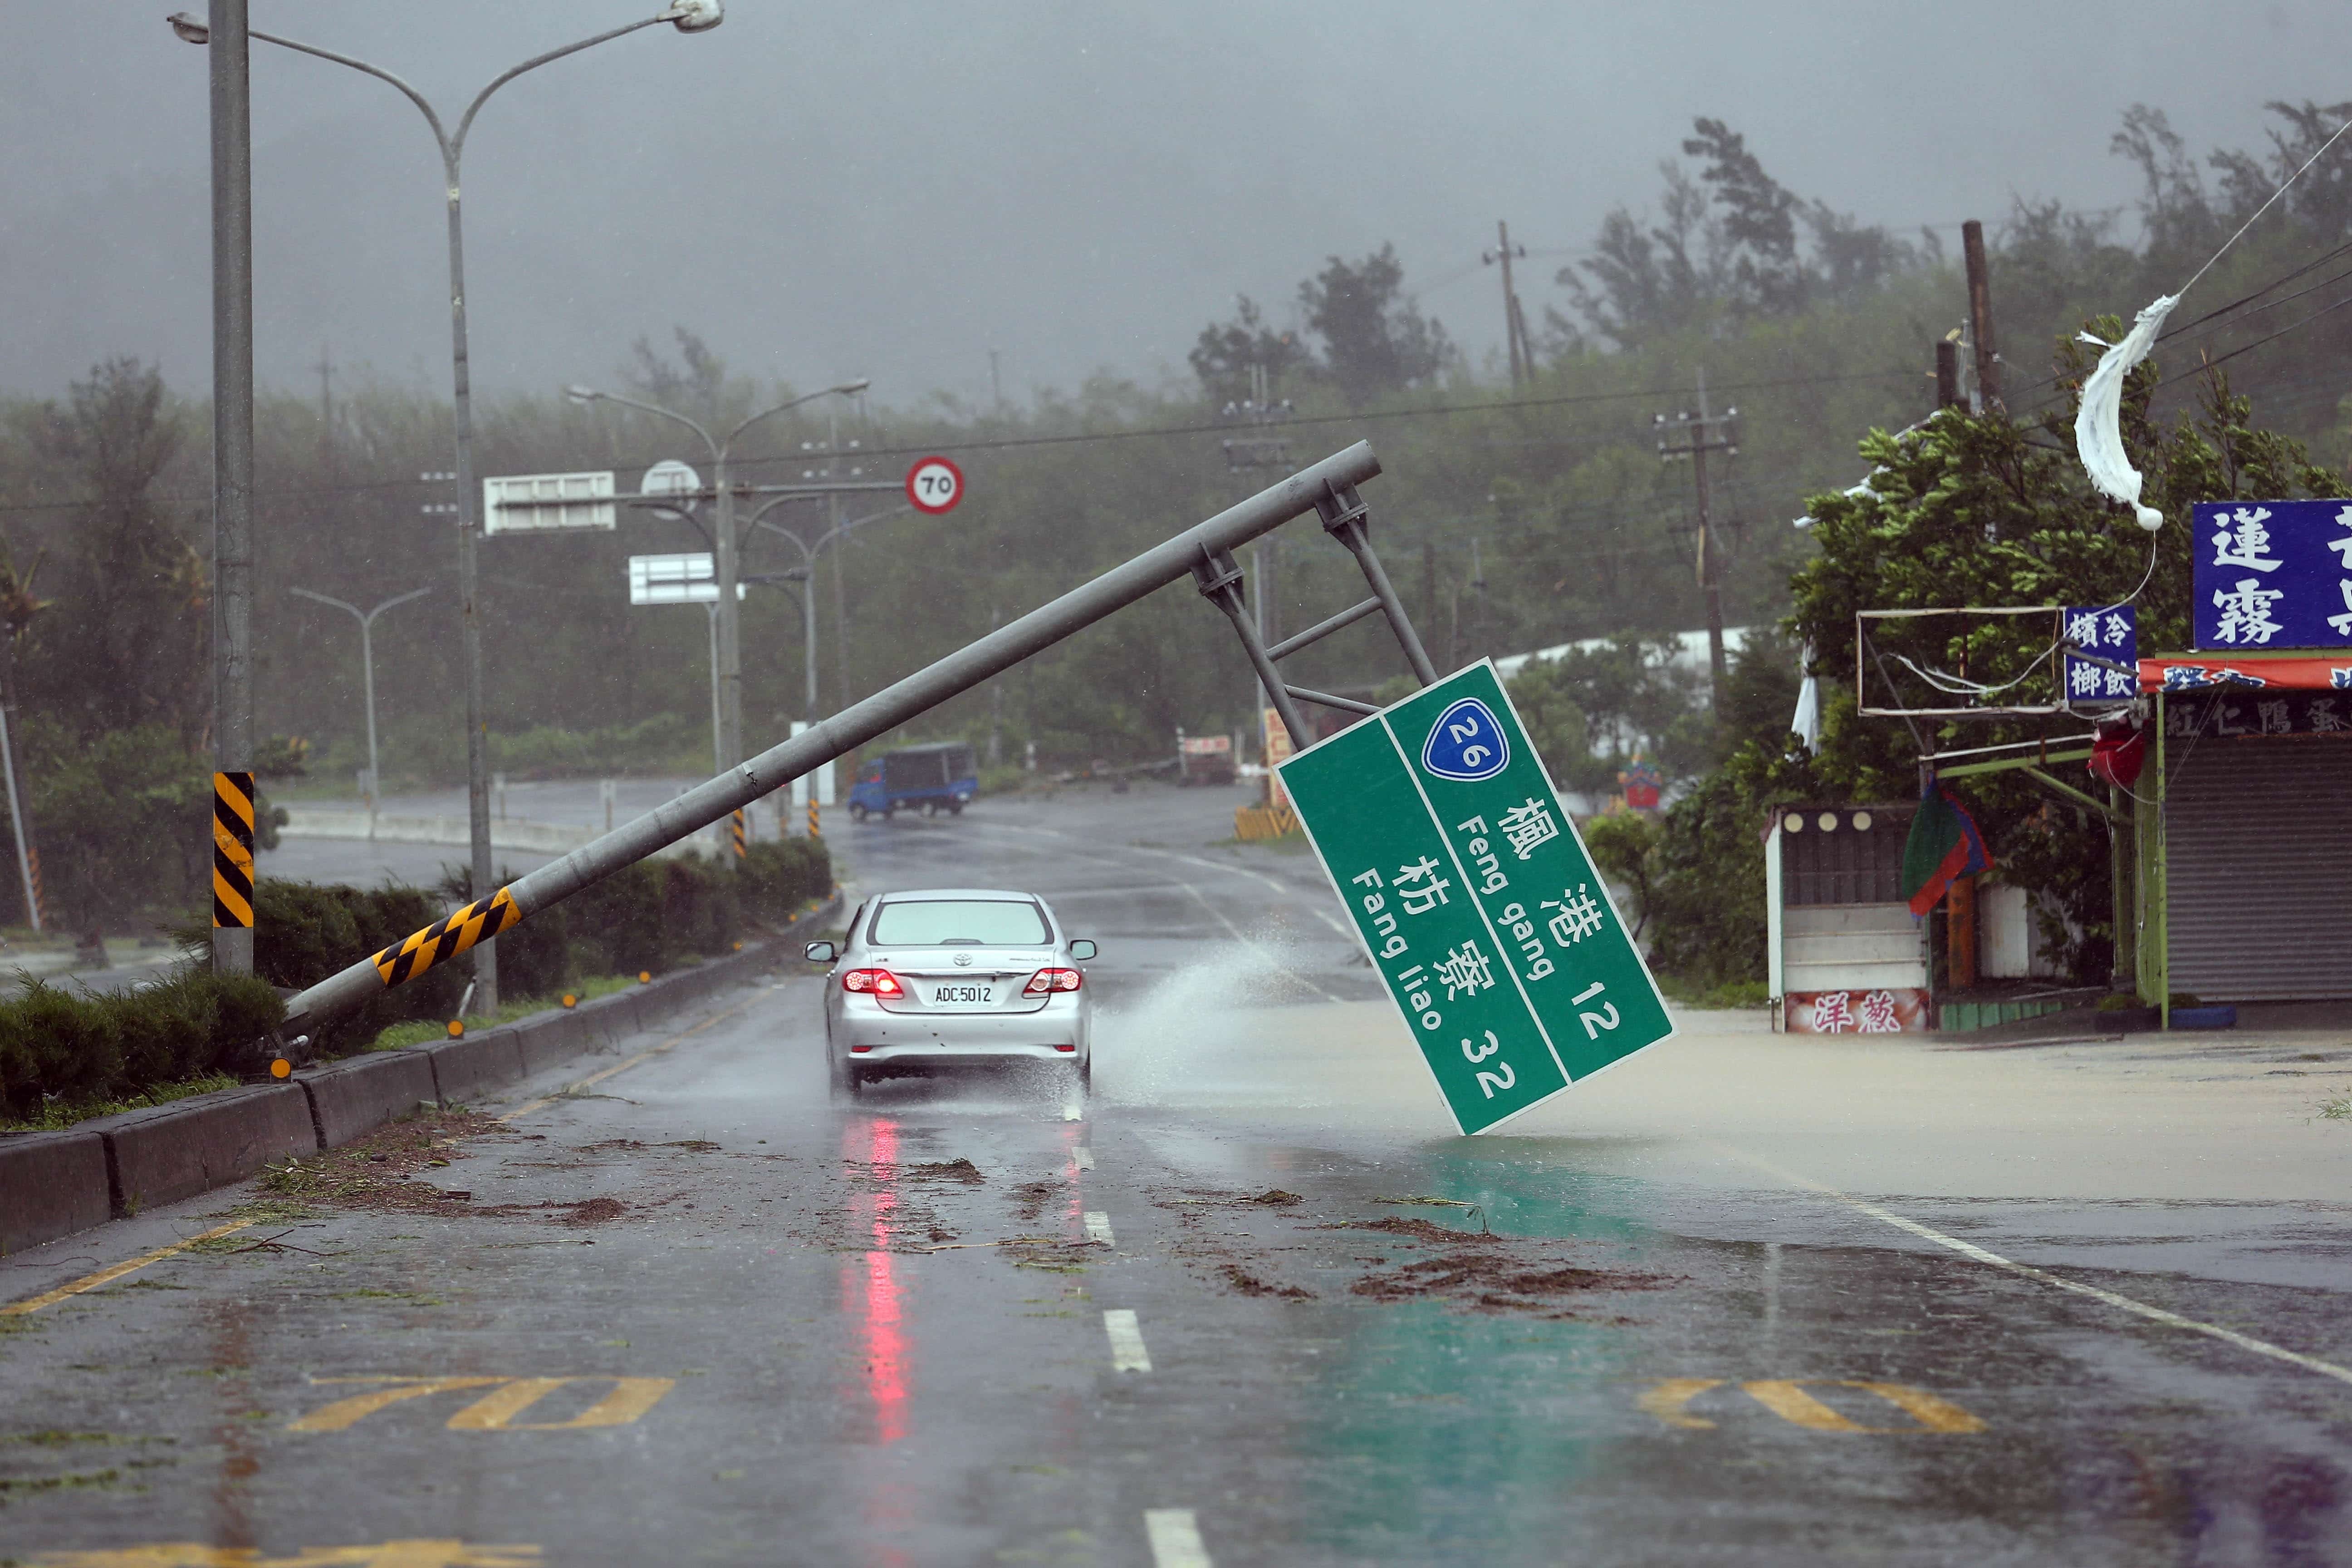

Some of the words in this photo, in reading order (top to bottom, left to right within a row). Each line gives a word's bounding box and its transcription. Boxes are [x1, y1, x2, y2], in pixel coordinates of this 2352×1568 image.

[921, 476, 952, 495] 70
[2211, 506, 2284, 643] 蓮霧
[2069, 612, 2101, 697] 檳榔
[2103, 612, 2133, 696] 冷飲
[1449, 716, 1491, 767] 26
[1352, 867, 1409, 959] Fang
[1398, 965, 1441, 1030] liao
[1457, 815, 1509, 895] Feng
[1497, 902, 1555, 981] gang
[1498, 797, 1603, 948] 楓港
[1571, 981, 1620, 1040] 12
[1392, 855, 1496, 1002] 枋寮
[1461, 1029, 1516, 1099] 32
[285, 1376, 677, 1431] 70
